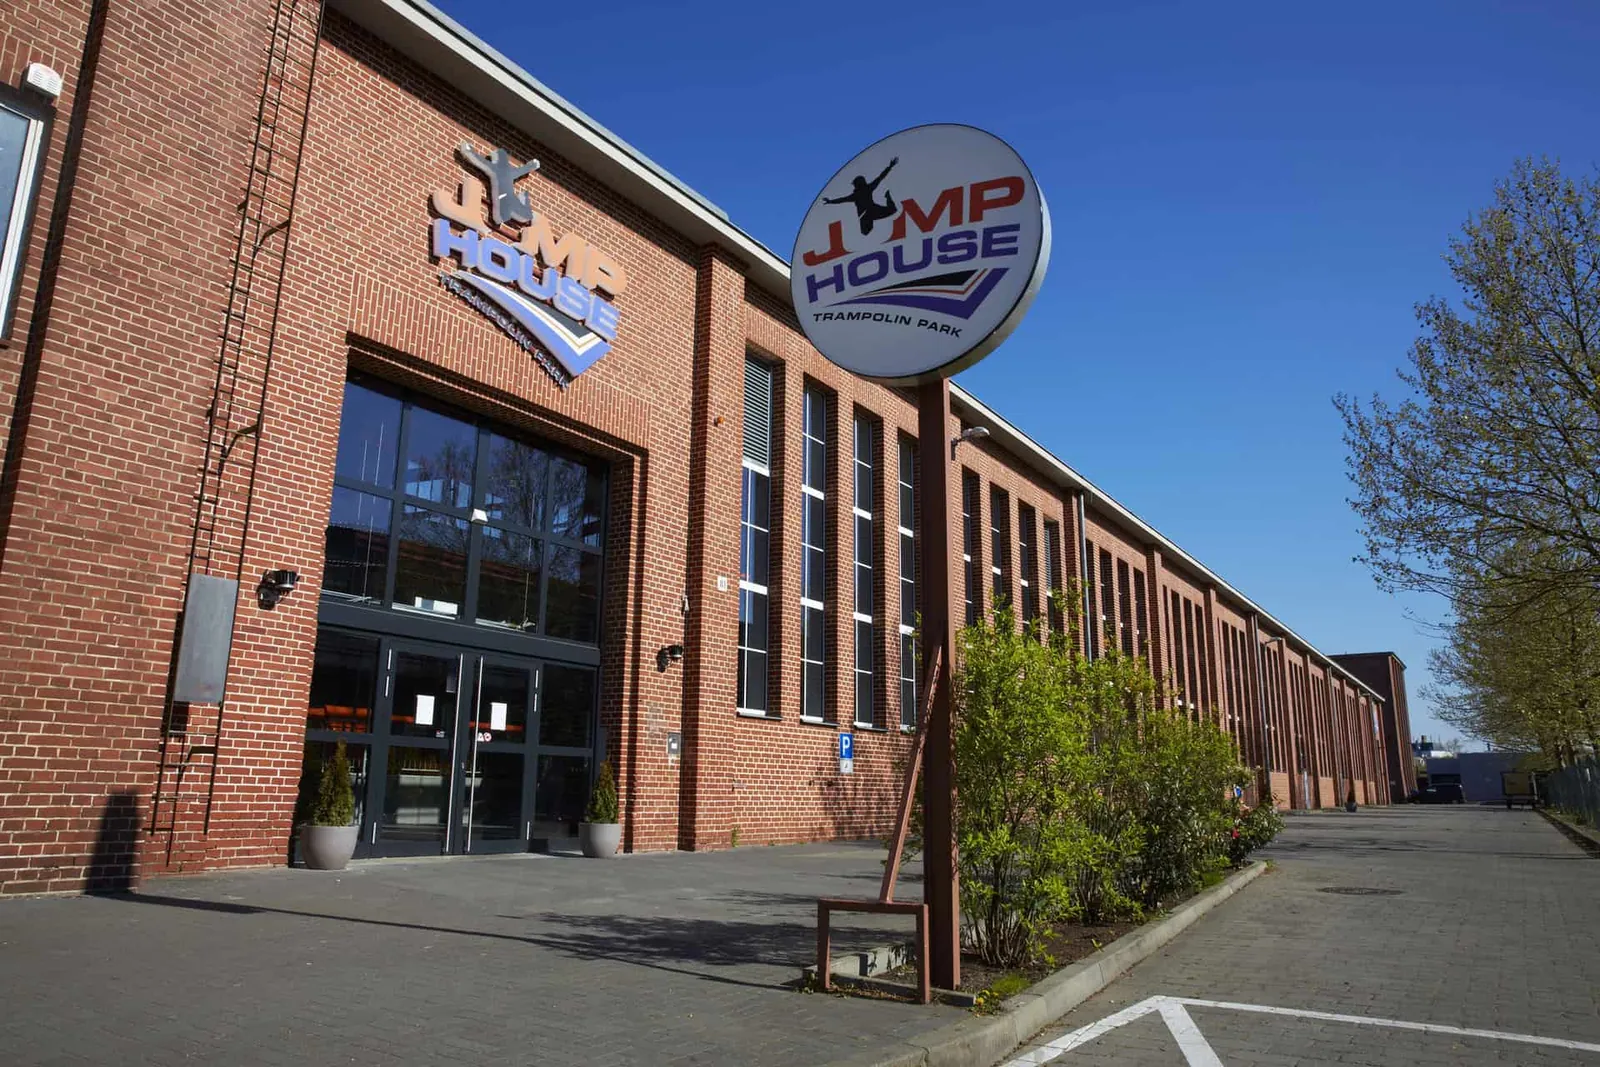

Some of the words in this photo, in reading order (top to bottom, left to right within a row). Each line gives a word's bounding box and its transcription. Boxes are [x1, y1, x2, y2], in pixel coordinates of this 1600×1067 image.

[432, 177, 627, 296] JMP
[802, 175, 1026, 267] JMP
[432, 217, 621, 342] HOUSE
[805, 223, 1021, 304] HOUSE
[439, 271, 532, 351] TRAMPOLIN
[813, 311, 912, 327] TRAMPOLIN
[916, 318, 963, 339] PARK
[842, 736, 850, 756] P
